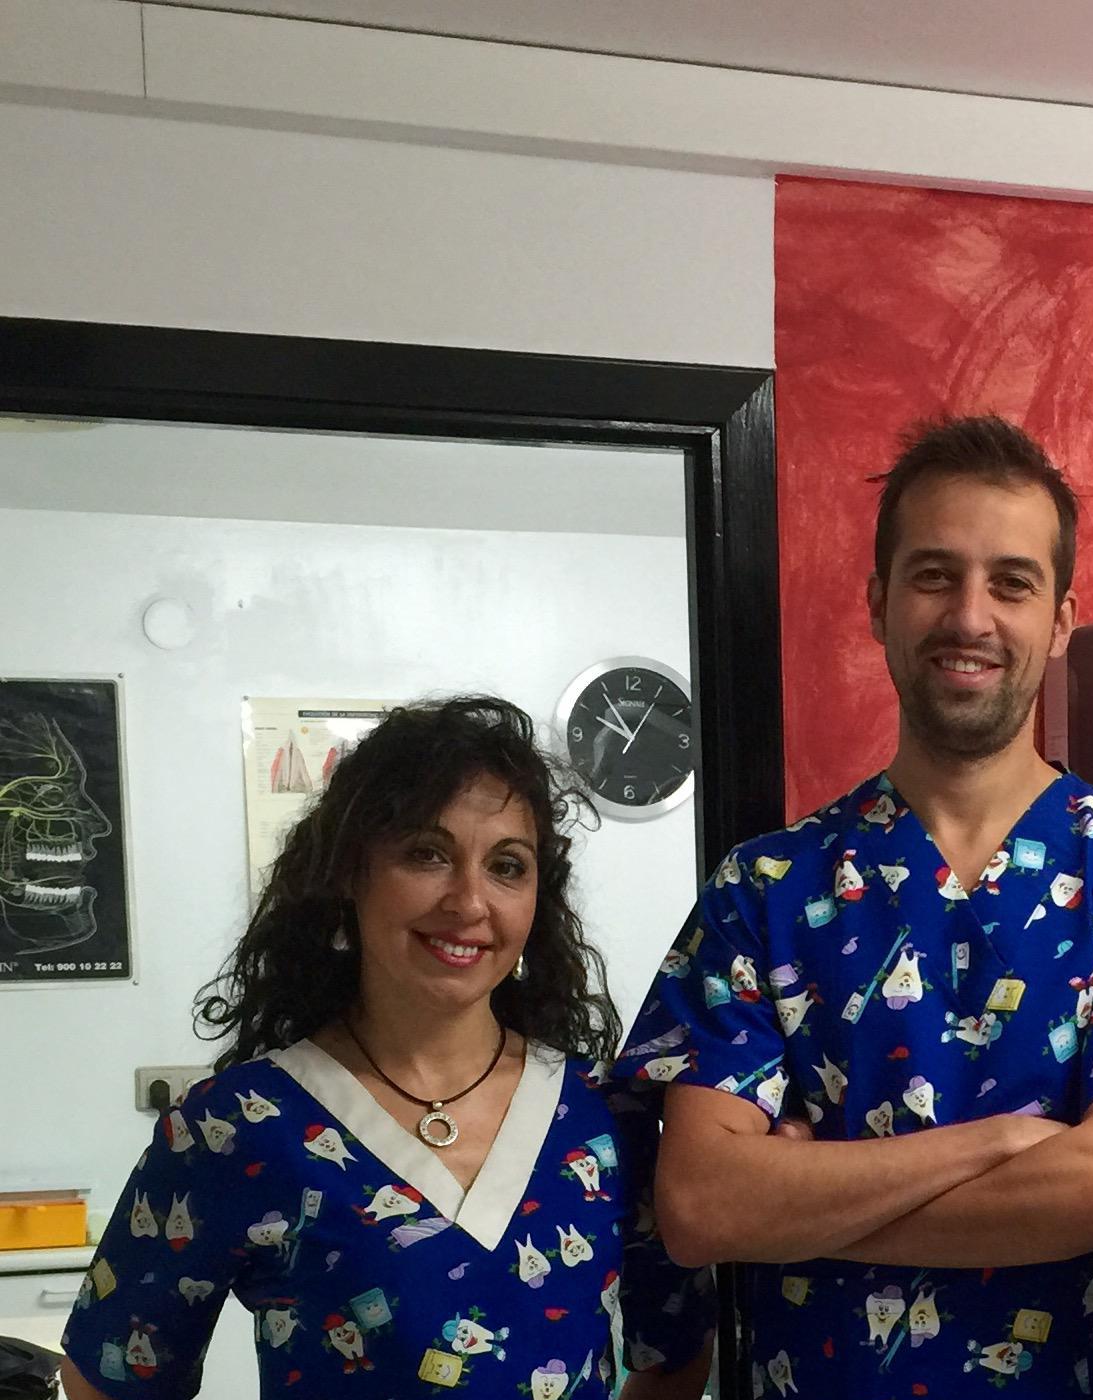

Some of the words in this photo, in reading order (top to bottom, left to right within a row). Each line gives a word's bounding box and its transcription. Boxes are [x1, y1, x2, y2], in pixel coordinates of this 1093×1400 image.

[626, 675, 641, 691] 12
[572, 727, 583, 742] 9
[678, 735, 690, 749] 3
[624, 785, 635, 799] 6
[56, 962, 76, 971] 900
[80, 962, 92, 971] 10
[94, 962, 107, 971] 22
[109, 961, 122, 970] 22
